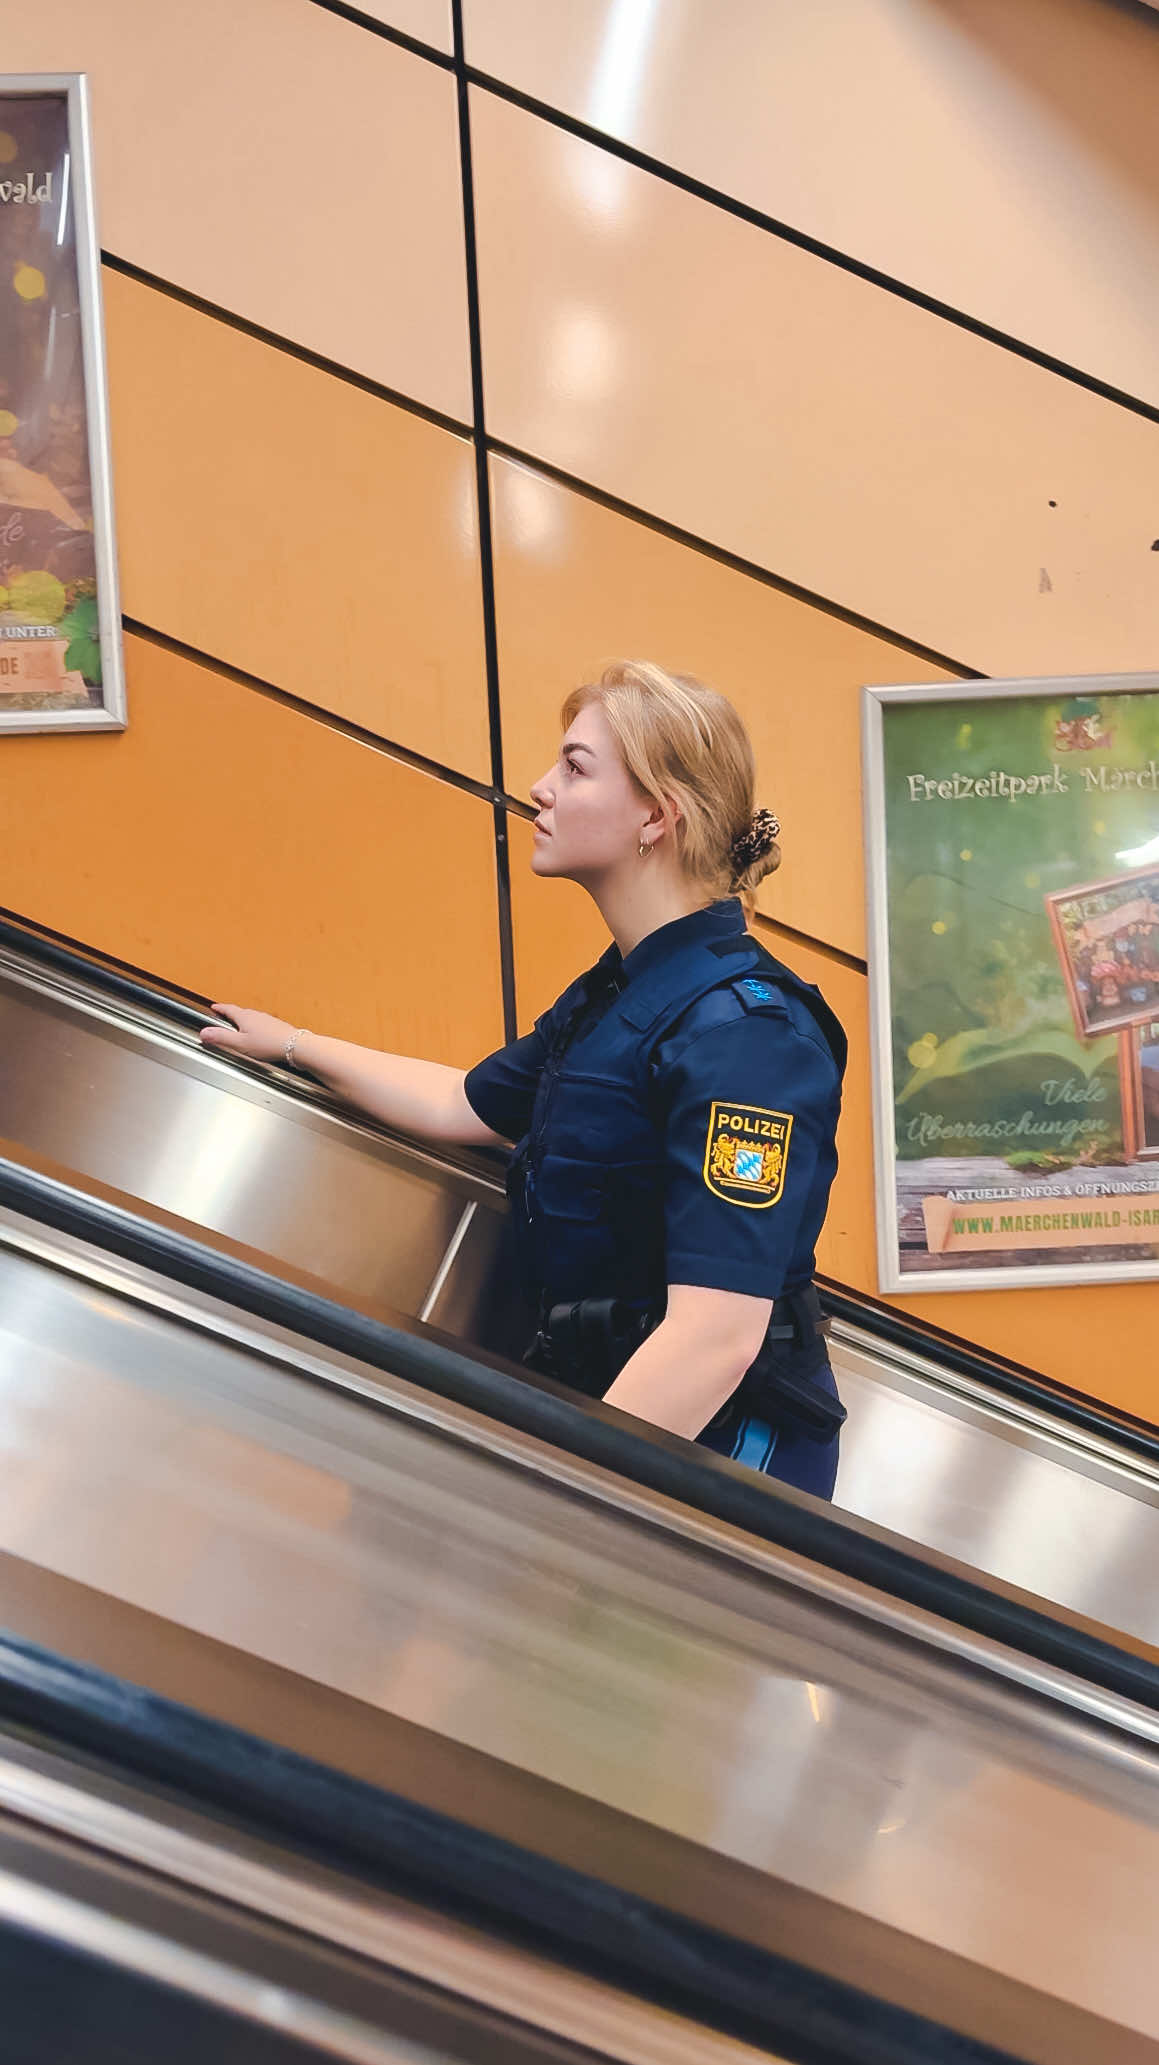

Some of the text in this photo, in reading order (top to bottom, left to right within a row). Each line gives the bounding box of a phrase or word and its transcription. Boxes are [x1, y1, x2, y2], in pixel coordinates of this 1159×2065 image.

[8, 625, 57, 638] UNTER
[906, 764, 1069, 802] Freizeitpark
[1040, 1078, 1108, 1106] Viele
[717, 1113, 785, 1140] POLIZEI
[946, 1187, 1017, 1201] AKTUELLE
[1020, 1185, 1061, 1198] INFOS
[1063, 1184, 1073, 1196] &
